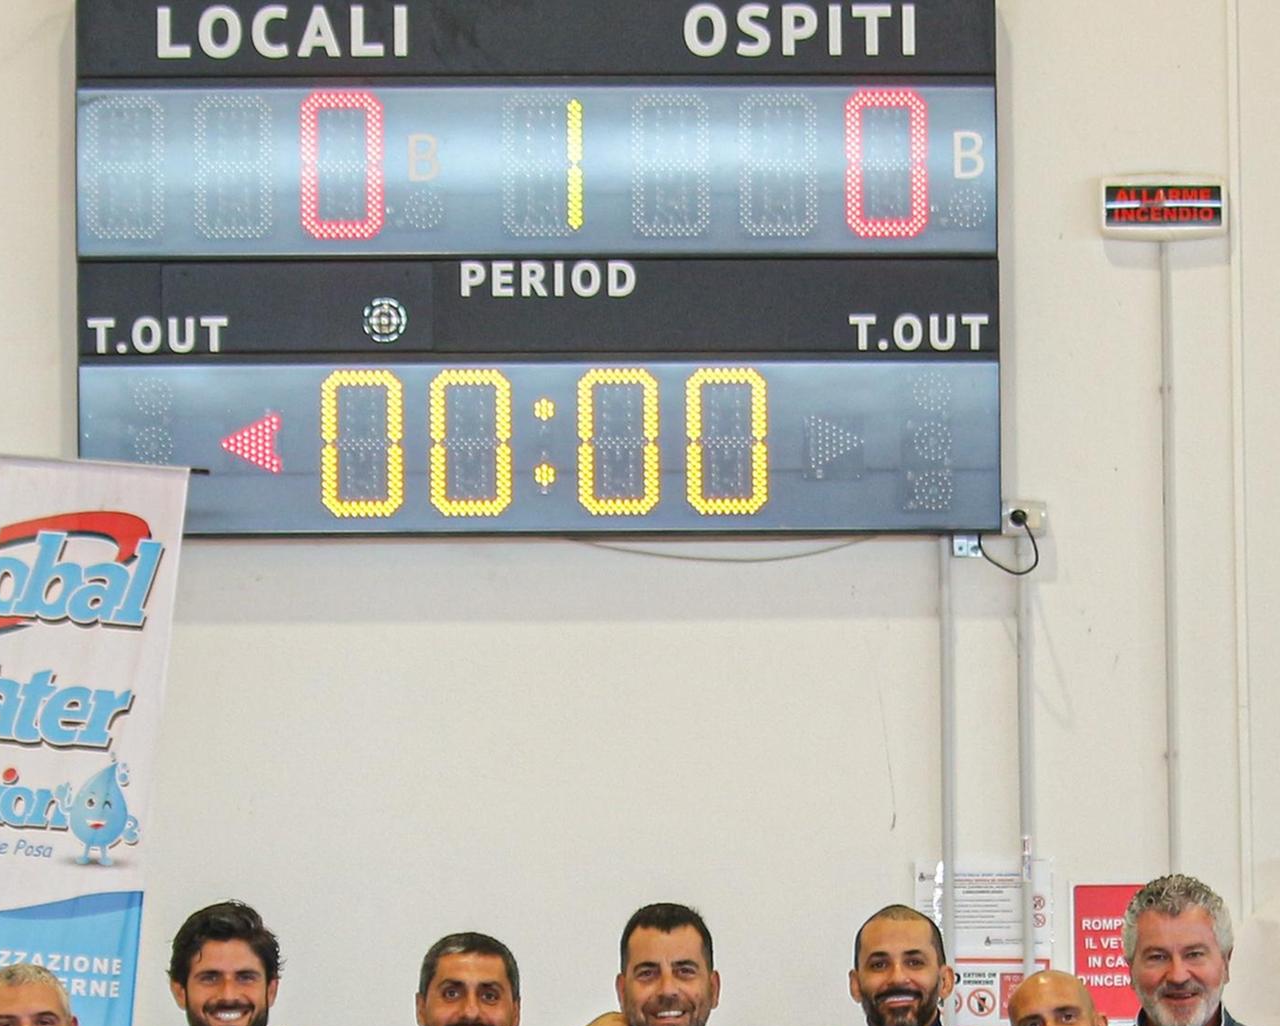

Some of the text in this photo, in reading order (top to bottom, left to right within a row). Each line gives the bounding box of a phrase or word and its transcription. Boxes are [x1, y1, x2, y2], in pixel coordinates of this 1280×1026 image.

[156, 5, 410, 59] LOCALI
[683, 3, 919, 58] OSPITI
[299, 89, 384, 239] 0
[408, 133, 441, 183] B
[566, 98, 584, 230] 1
[844, 87, 928, 239] 0
[953, 130, 986, 181] B
[1113, 206, 1216, 222] INCENDIO
[1115, 188, 1213, 203] ALLARME
[460, 261, 637, 298] PERIOD
[87, 316, 229, 354] T.OUT
[848, 312, 990, 351] T.OUT
[320, 368, 769, 518] 00:00
[13, 838, 54, 859] Posa
[1085, 937, 1097, 950] IL
[1088, 956, 1130, 969] IN CA
